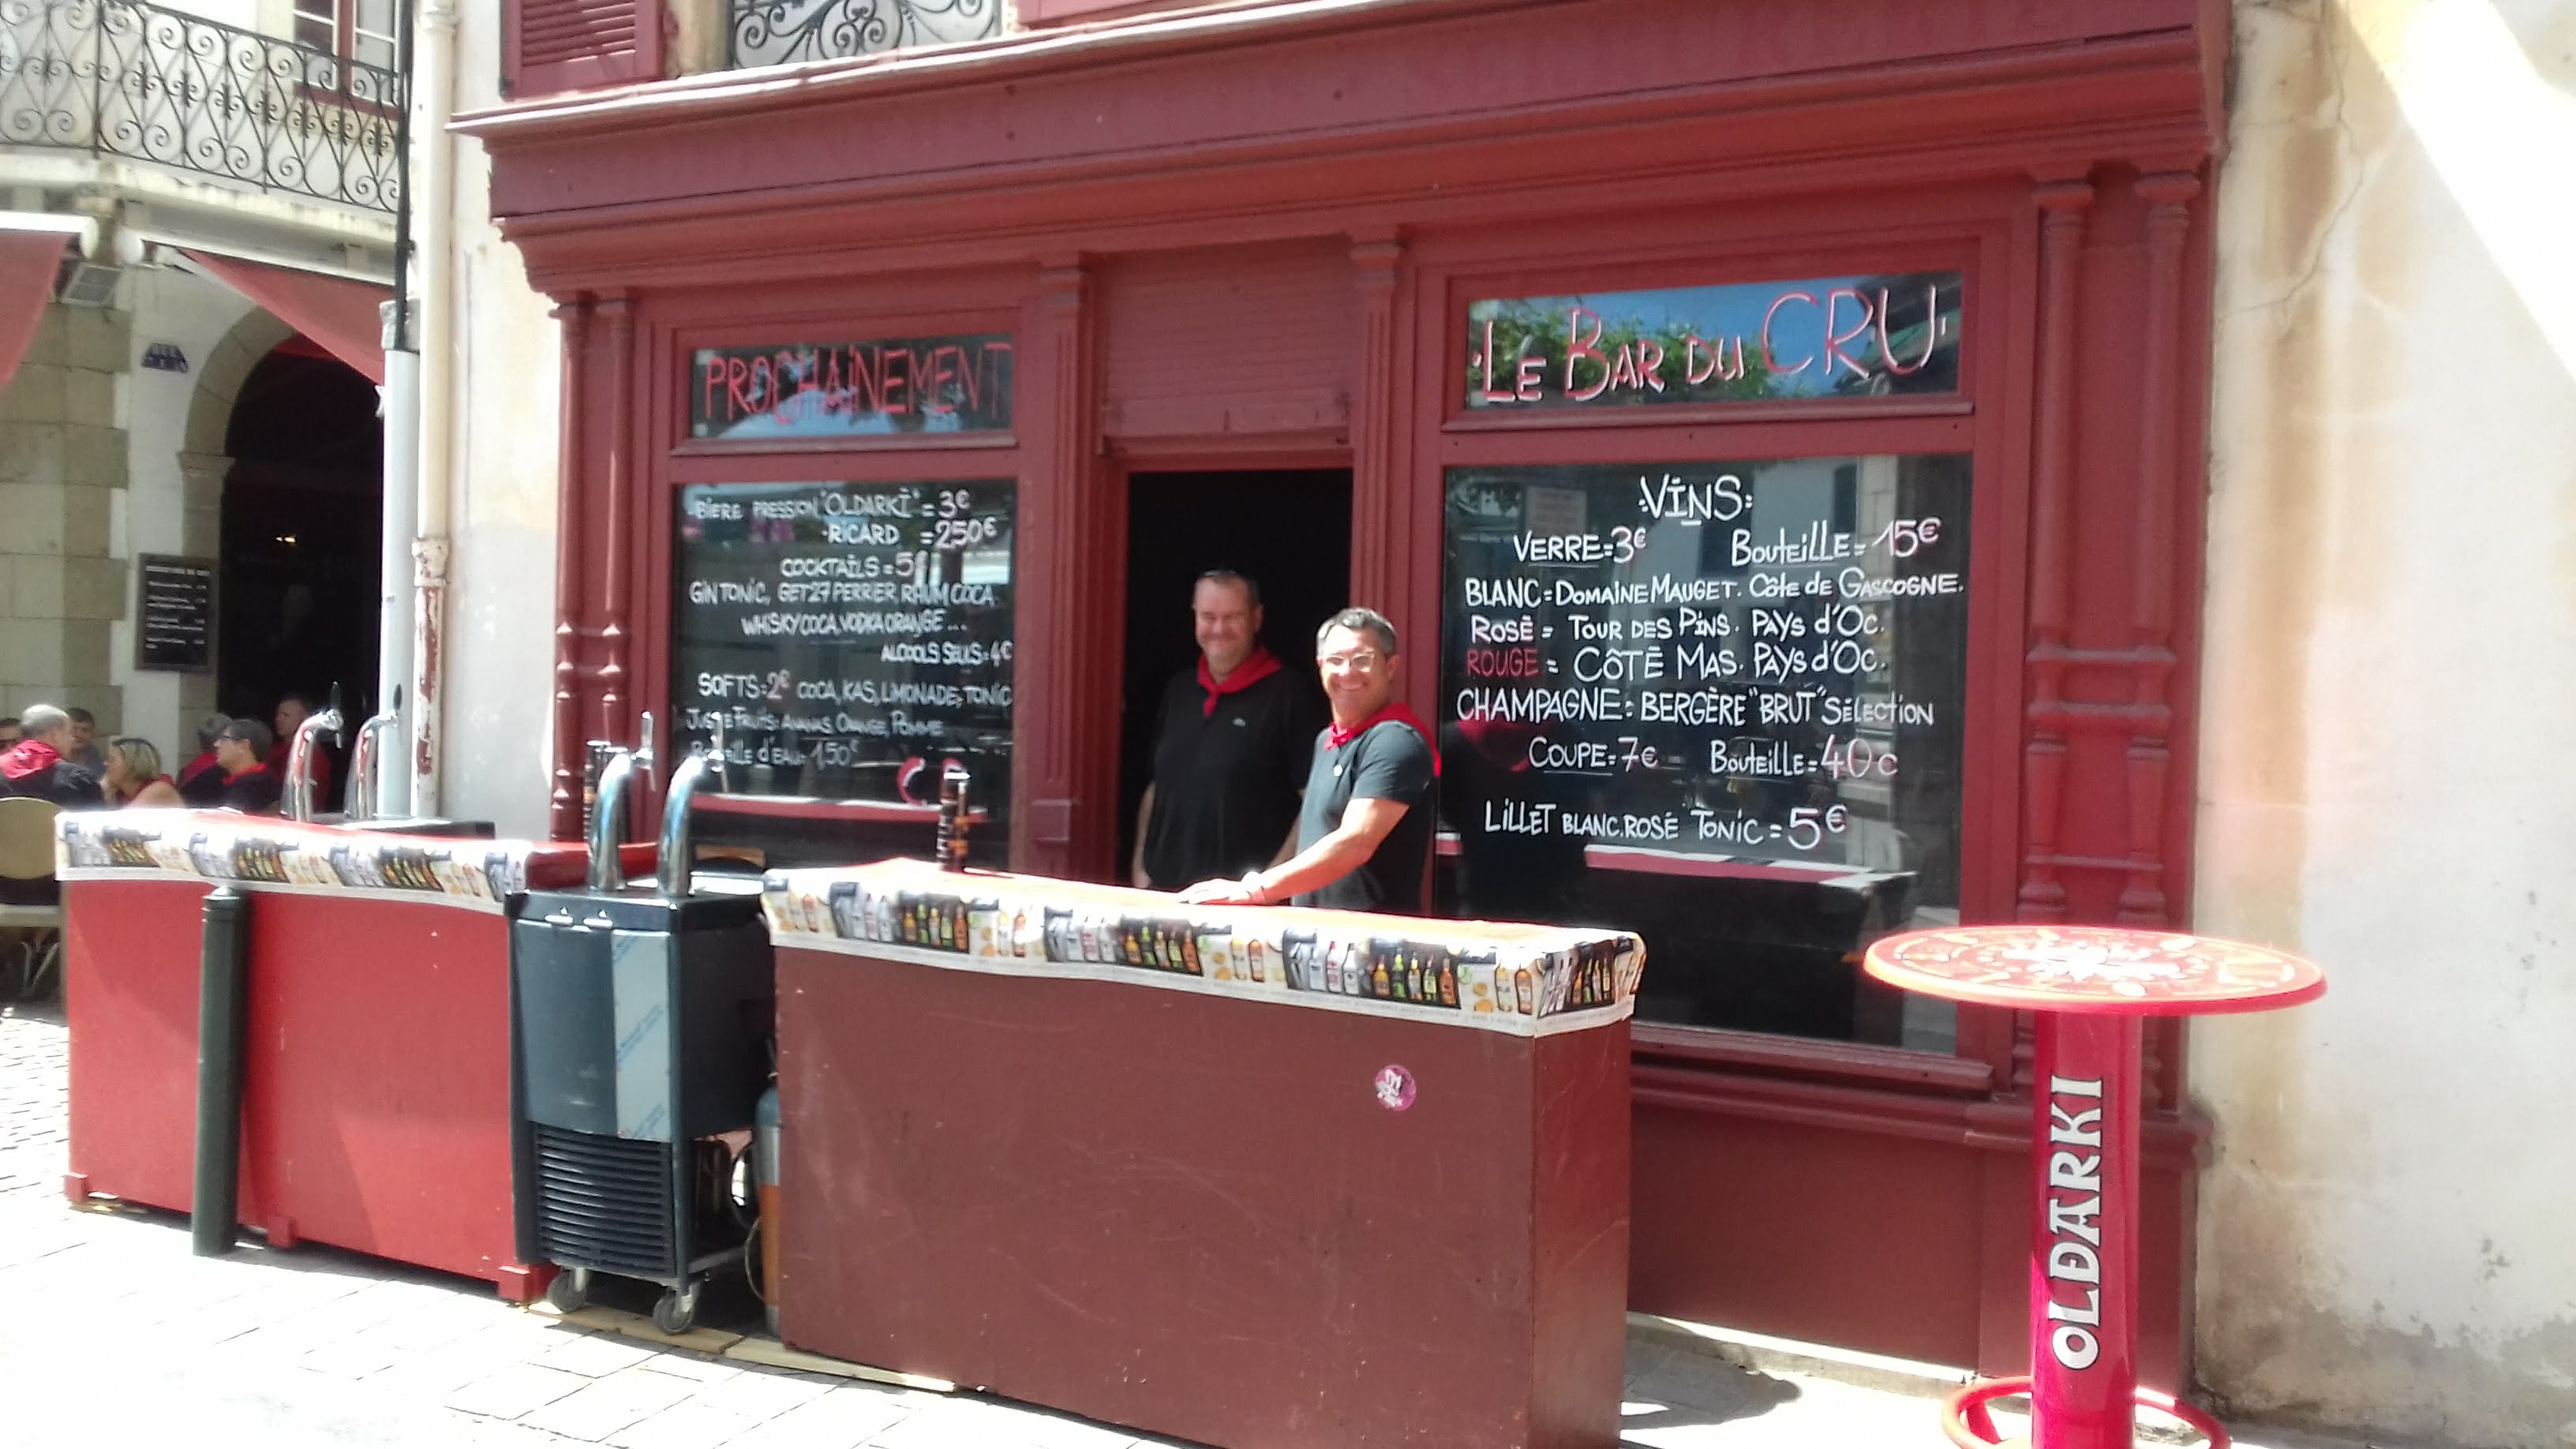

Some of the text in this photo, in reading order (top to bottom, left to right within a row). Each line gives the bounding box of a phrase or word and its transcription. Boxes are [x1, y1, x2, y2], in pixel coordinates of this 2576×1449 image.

[1565, 307, 1665, 401] BAR
[1685, 335, 1744, 385] DU
[706, 343, 1012, 425] PROCHAINEMENT
[827, 523, 900, 545] RICARD
[689, 579, 718, 605] GIN
[1470, 614, 1534, 644] ROSÉ
[1567, 614, 1623, 641] TOUR
[1631, 616, 1673, 639] DES
[1466, 647, 1539, 677] ROUGE
[1485, 797, 1557, 837] LILLET
[1690, 807, 1764, 845] TONIC
[1787, 803, 1848, 851] 5€
[2048, 1074, 2103, 1371] OLDARKI
